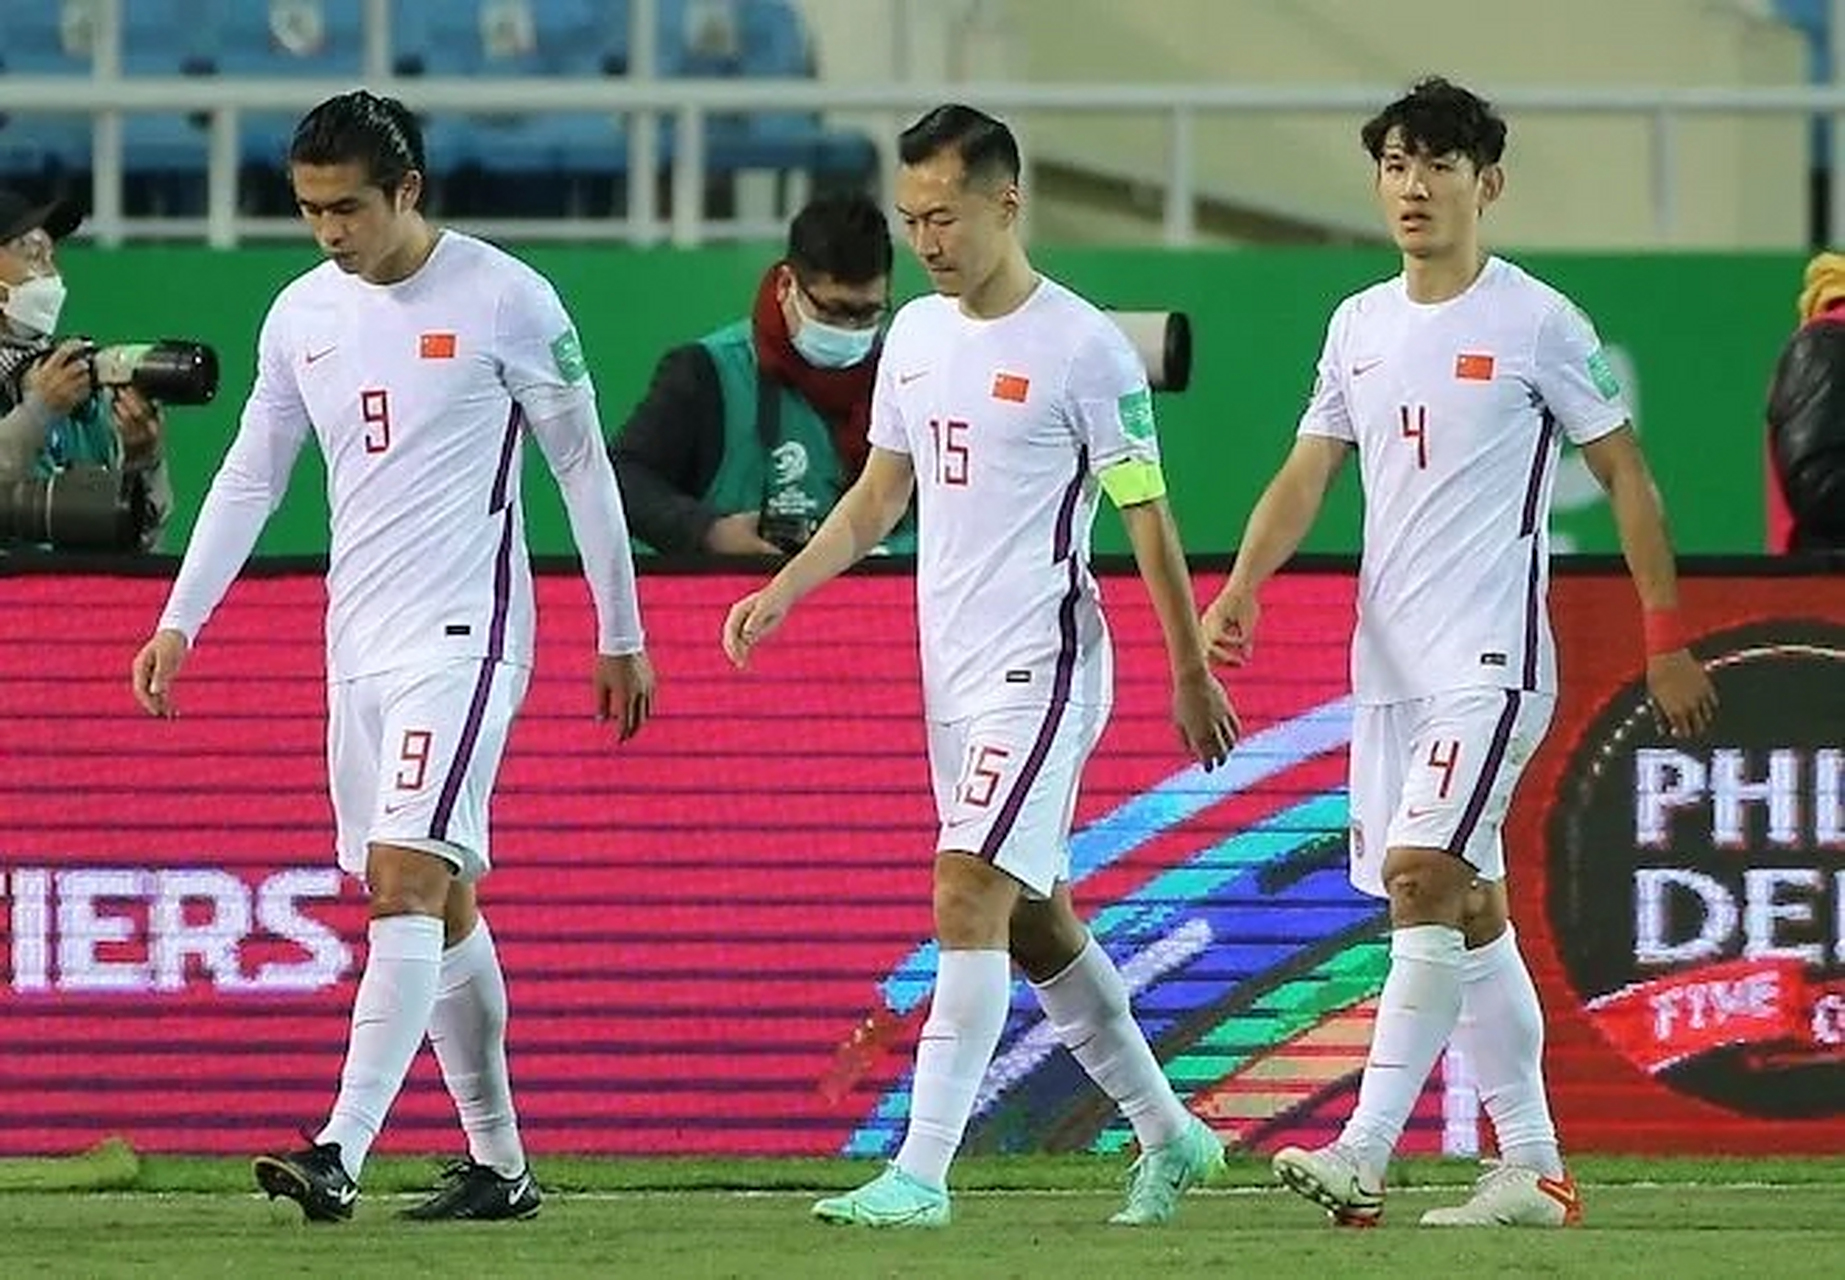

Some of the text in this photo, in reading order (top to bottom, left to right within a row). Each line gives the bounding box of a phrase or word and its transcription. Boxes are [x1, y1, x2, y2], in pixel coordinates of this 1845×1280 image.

[361, 390, 390, 453] 9
[930, 420, 969, 486] 15
[1400, 405, 1427, 470] 4
[396, 730, 432, 790] 9
[955, 745, 1009, 808] 15
[1428, 740, 1460, 799] 4
[0, 867, 352, 990] IERS
[1649, 969, 1779, 1041] FIVE
